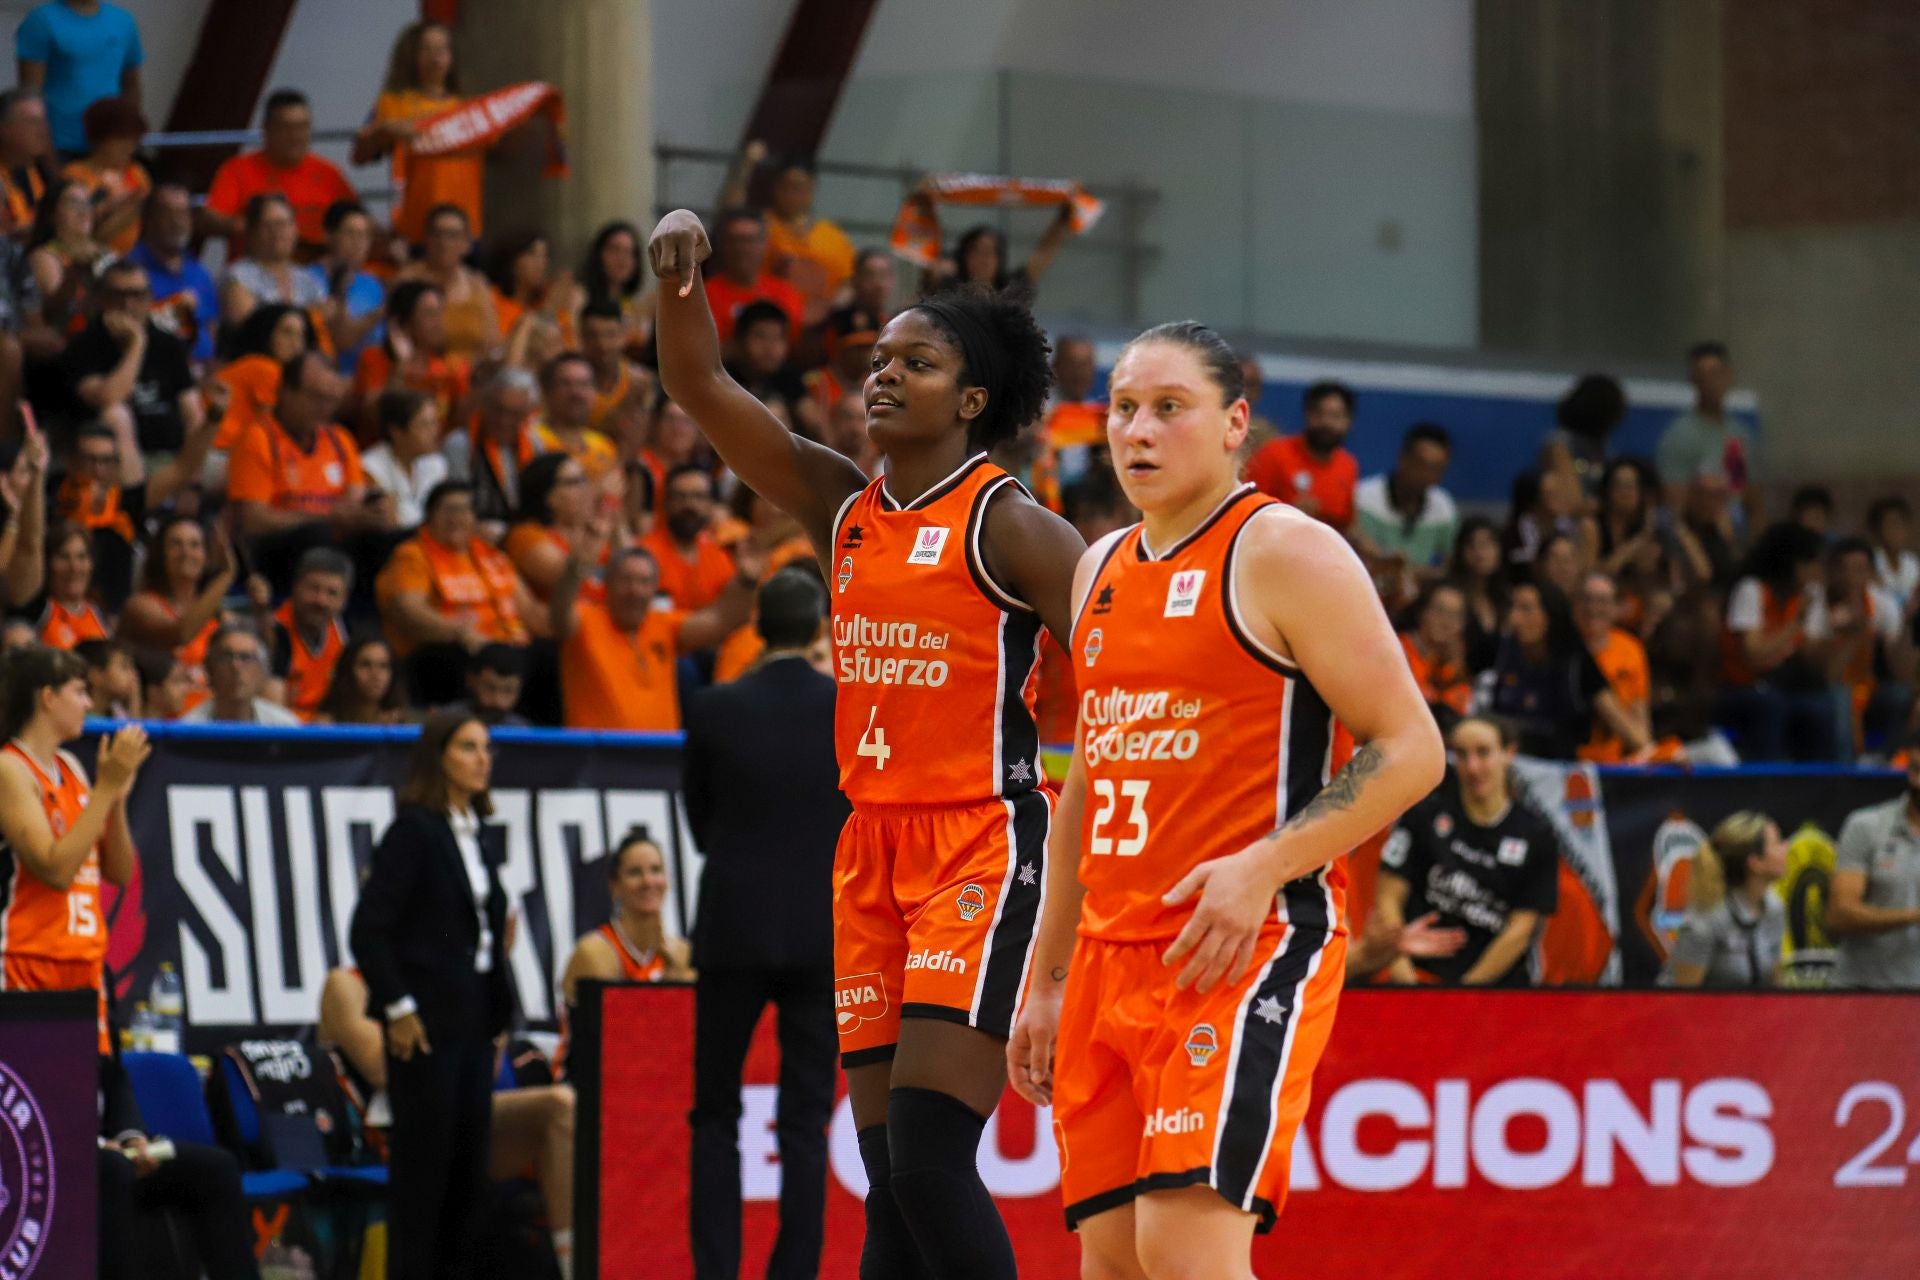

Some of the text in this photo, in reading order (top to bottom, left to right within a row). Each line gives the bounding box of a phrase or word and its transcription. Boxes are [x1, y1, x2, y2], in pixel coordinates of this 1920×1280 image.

[834, 613, 949, 650] Cultura del
[839, 648, 949, 688] sfuerzo
[1082, 686, 1201, 726] Cultura del
[857, 705, 891, 770] 4
[1091, 779, 1151, 856] 23
[67, 892, 98, 936] 15
[1833, 1080, 1920, 1188] 2
